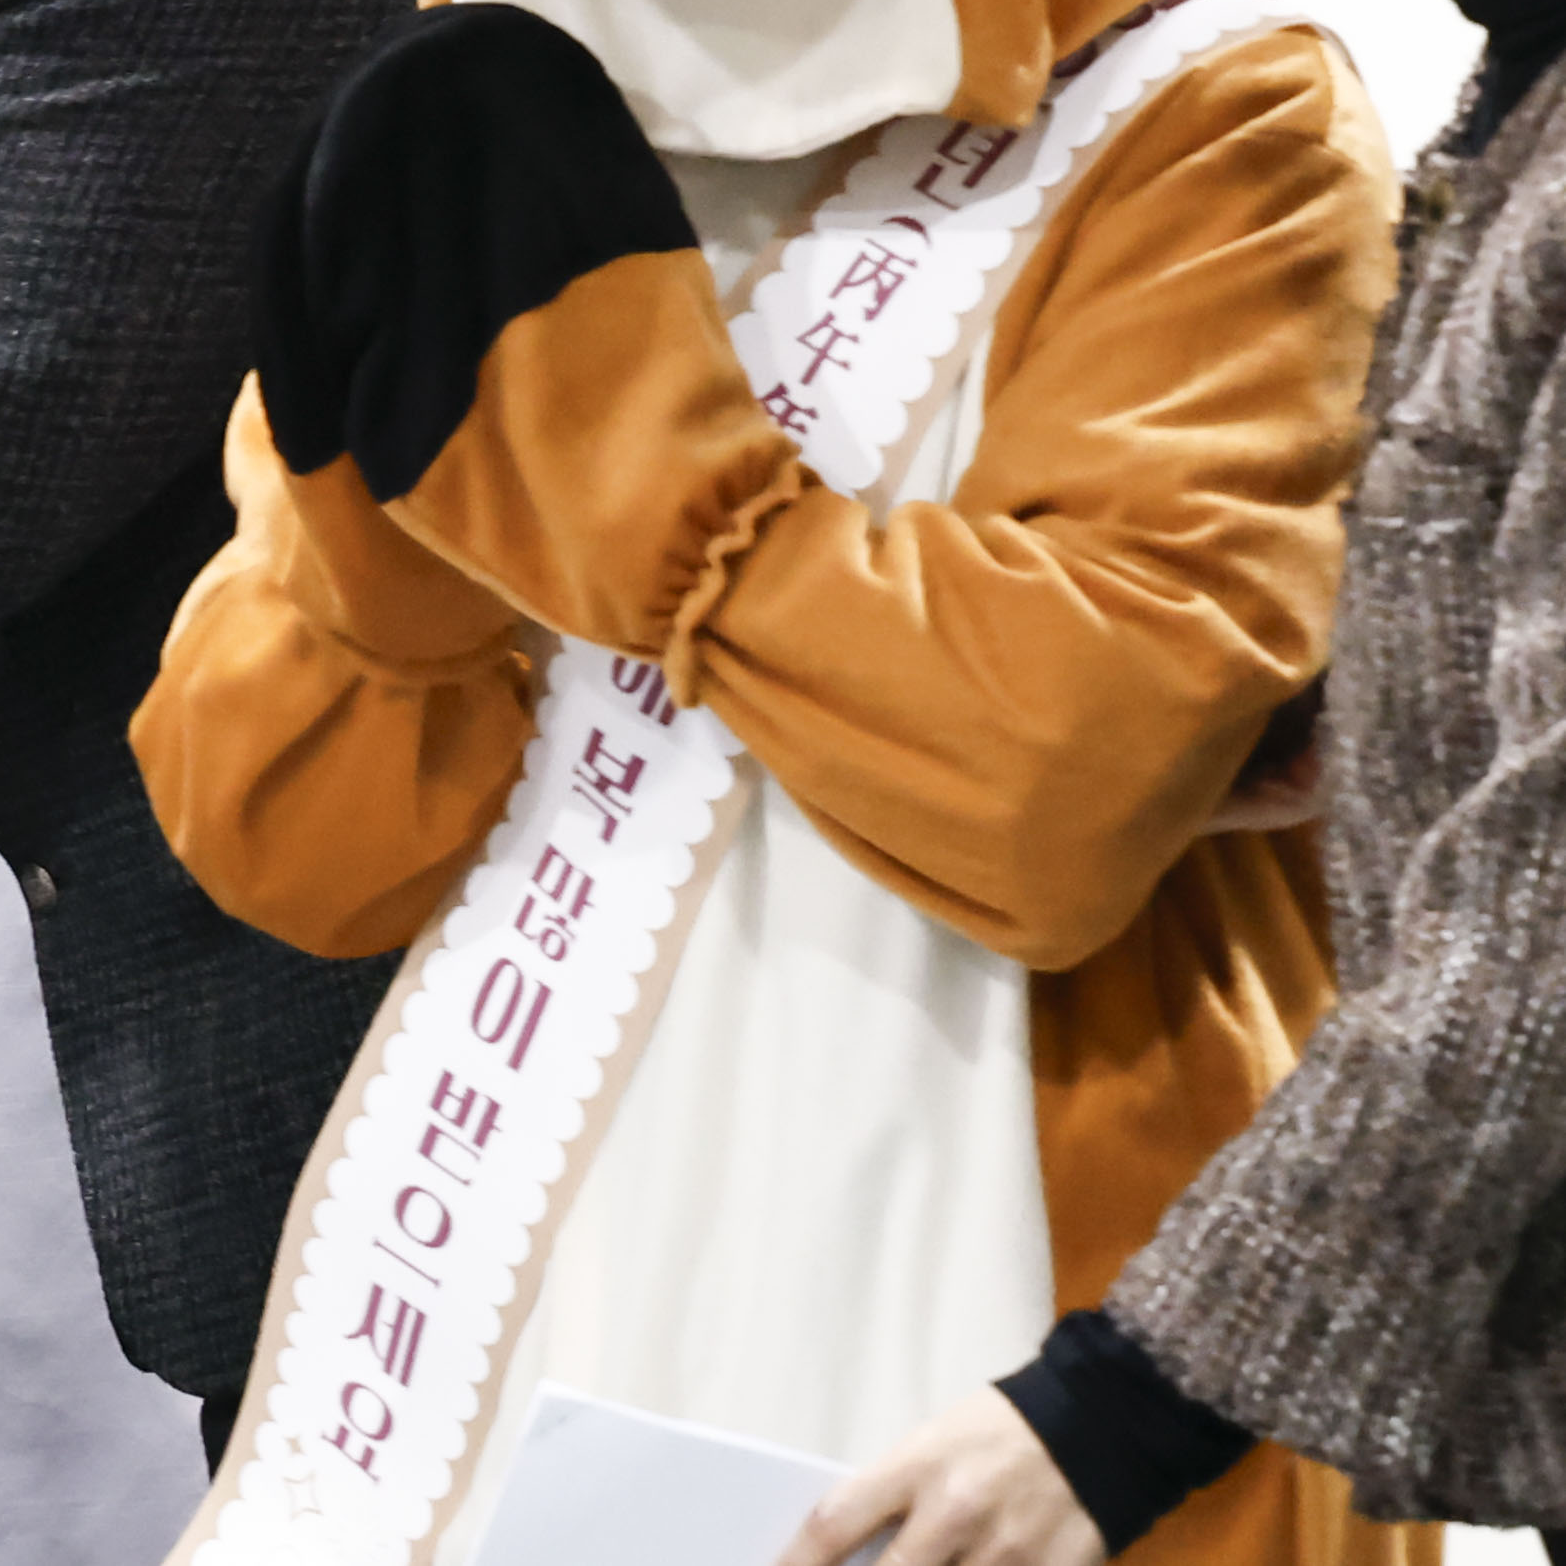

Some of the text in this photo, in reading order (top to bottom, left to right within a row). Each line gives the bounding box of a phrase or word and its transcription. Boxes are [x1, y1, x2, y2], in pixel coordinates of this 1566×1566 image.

[572, 727, 647, 844] 복
[471, 843, 595, 1071] 많이
[321, 1069, 502, 1484] 받으세요
